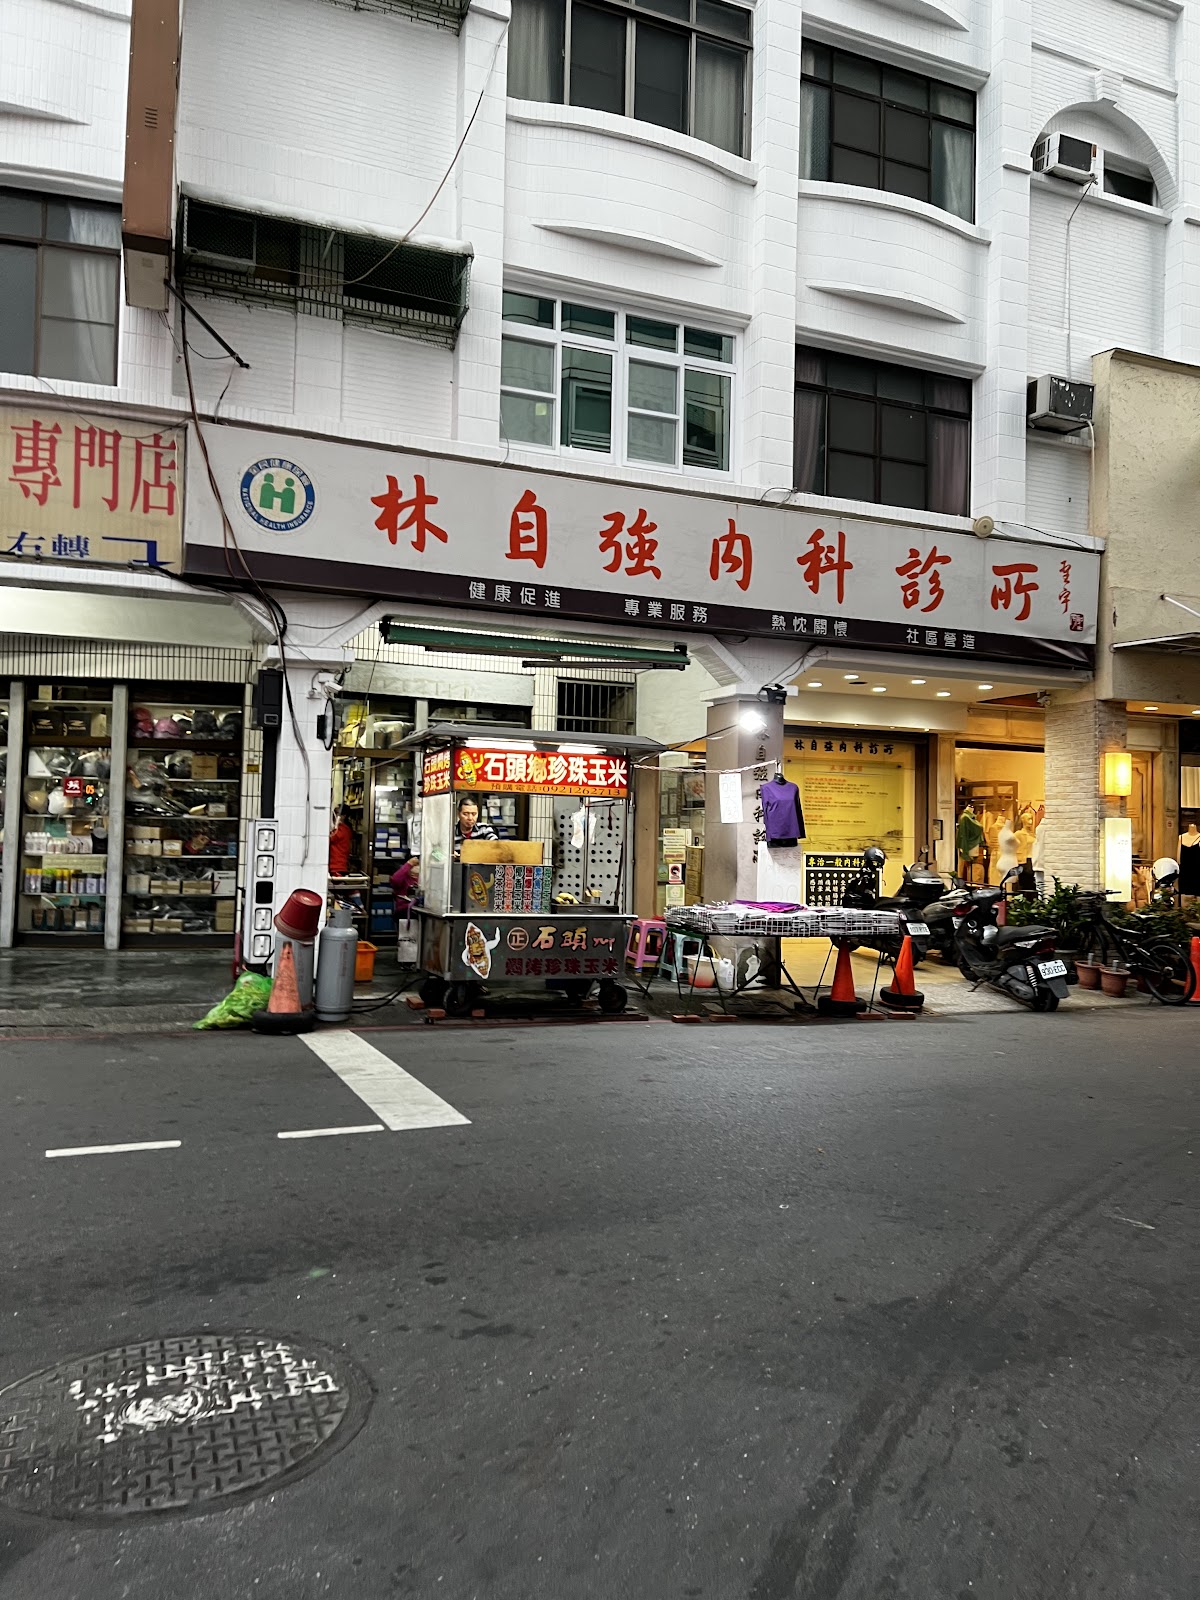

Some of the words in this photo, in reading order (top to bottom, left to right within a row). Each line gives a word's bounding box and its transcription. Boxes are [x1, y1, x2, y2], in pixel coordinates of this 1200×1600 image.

[8, 419, 177, 516] 專門店
[259, 518, 287, 530] HEALTH
[287, 500, 314, 530] INSURANCE
[370, 474, 1039, 621] 林自強內科診所
[468, 580, 561, 609] 健康促進
[624, 598, 709, 623] 專業服務
[771, 614, 848, 637] 熱忱關懷
[906, 627, 976, 650] 社區營造
[423, 770, 451, 793] 珍珠玉米
[484, 753, 628, 787] 石頭鄉珍珠玉米
